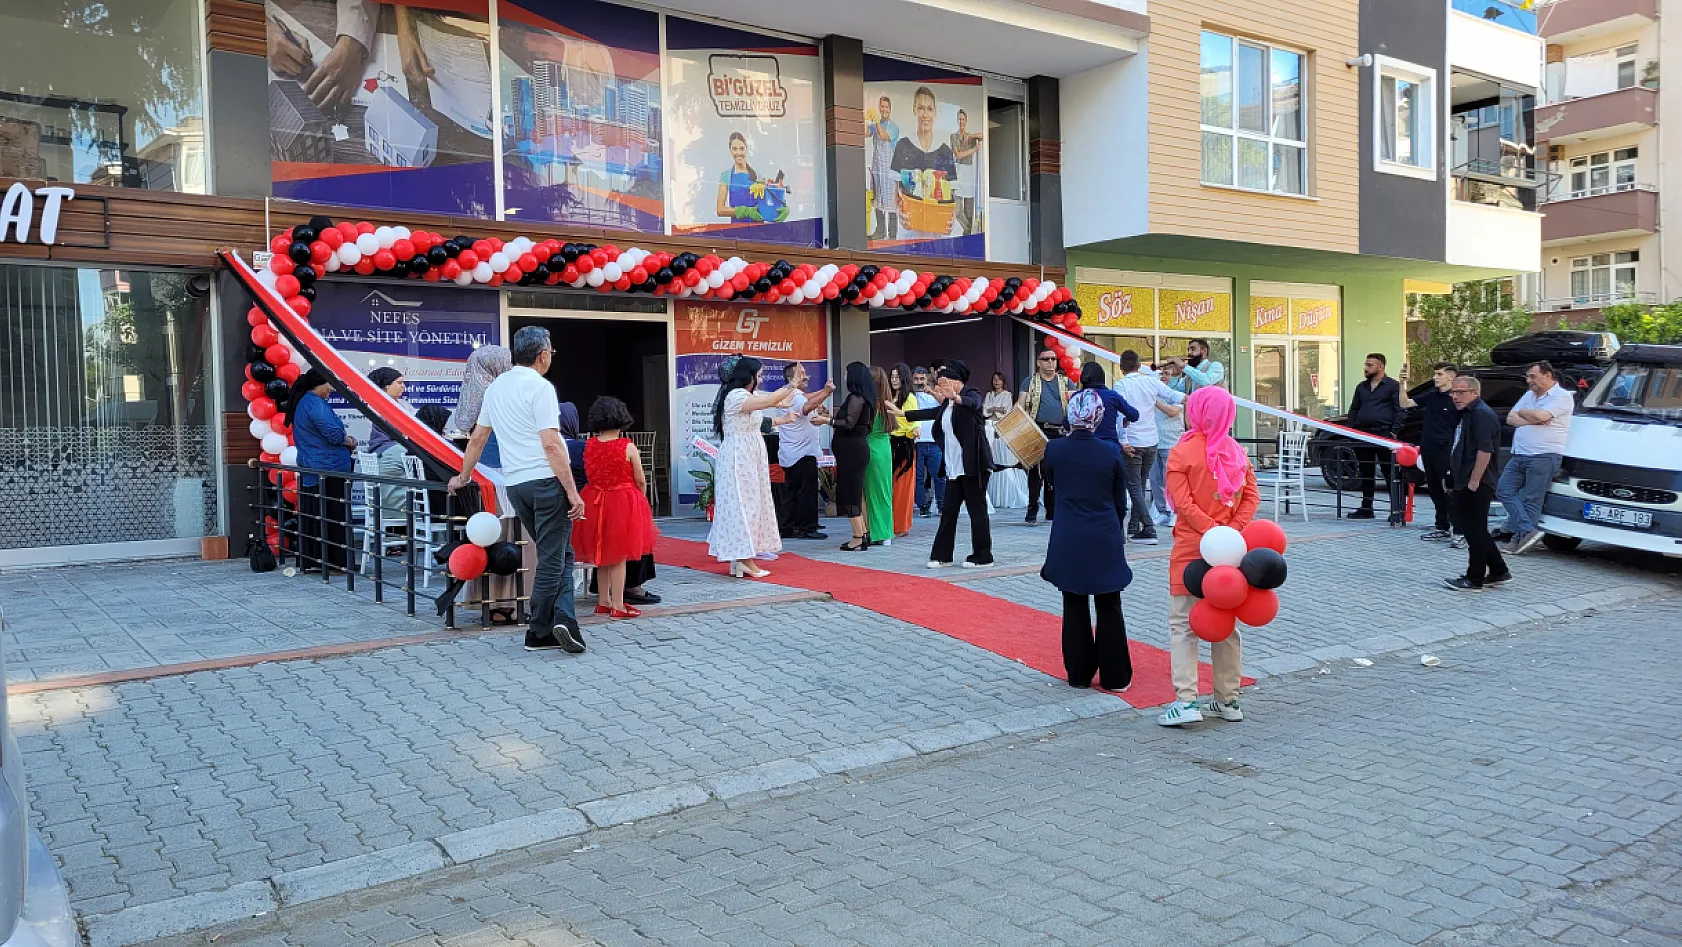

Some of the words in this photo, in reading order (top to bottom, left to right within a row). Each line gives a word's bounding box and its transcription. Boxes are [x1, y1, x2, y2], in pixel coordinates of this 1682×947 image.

[370, 311, 420, 324] NEFES
[1098, 290, 1132, 323] Söz
[1174, 296, 1215, 325] Nişan
[1255, 304, 1283, 328] Kına
[1299, 305, 1332, 330] Düğün
[735, 308, 769, 338] GT
[341, 329, 363, 342] VE
[367, 329, 403, 343] SİTE
[409, 330, 487, 345] YÖNETİMİ
[712, 338, 744, 350] GİZEM
[747, 339, 793, 351] TEMİZLİK
[1607, 508, 1626, 520] ARF
[1633, 511, 1651, 525] 183
